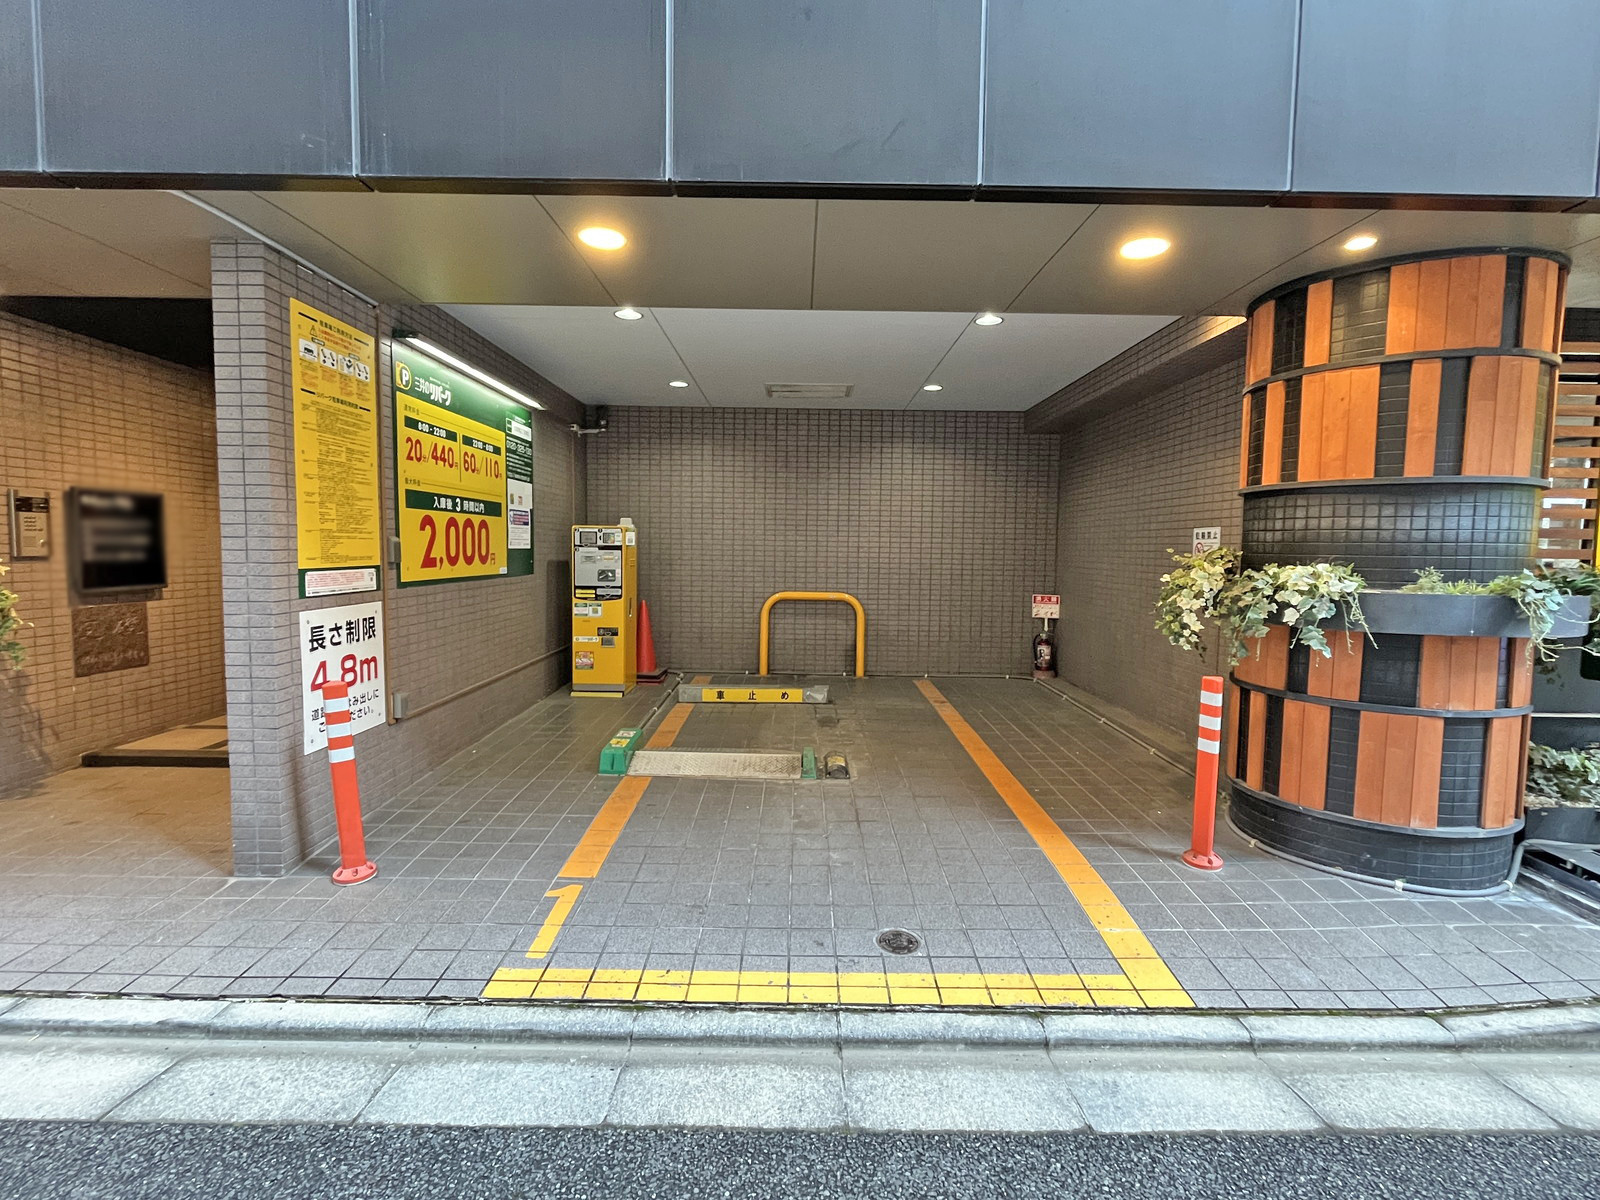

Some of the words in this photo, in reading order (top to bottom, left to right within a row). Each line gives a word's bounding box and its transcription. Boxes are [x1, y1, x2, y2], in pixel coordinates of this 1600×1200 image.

[402, 369, 409, 385] P
[414, 376, 451, 406] 三井のリパーク
[433, 496, 453, 510] 入庫後
[455, 498, 461, 512] 3
[463, 500, 485, 513] 時間以内
[419, 514, 496, 570] 2,000円
[309, 616, 376, 653] 長さ制限
[310, 653, 378, 692] 48m
[716, 690, 789, 701] 車止め
[525, 884, 583, 959] 1
